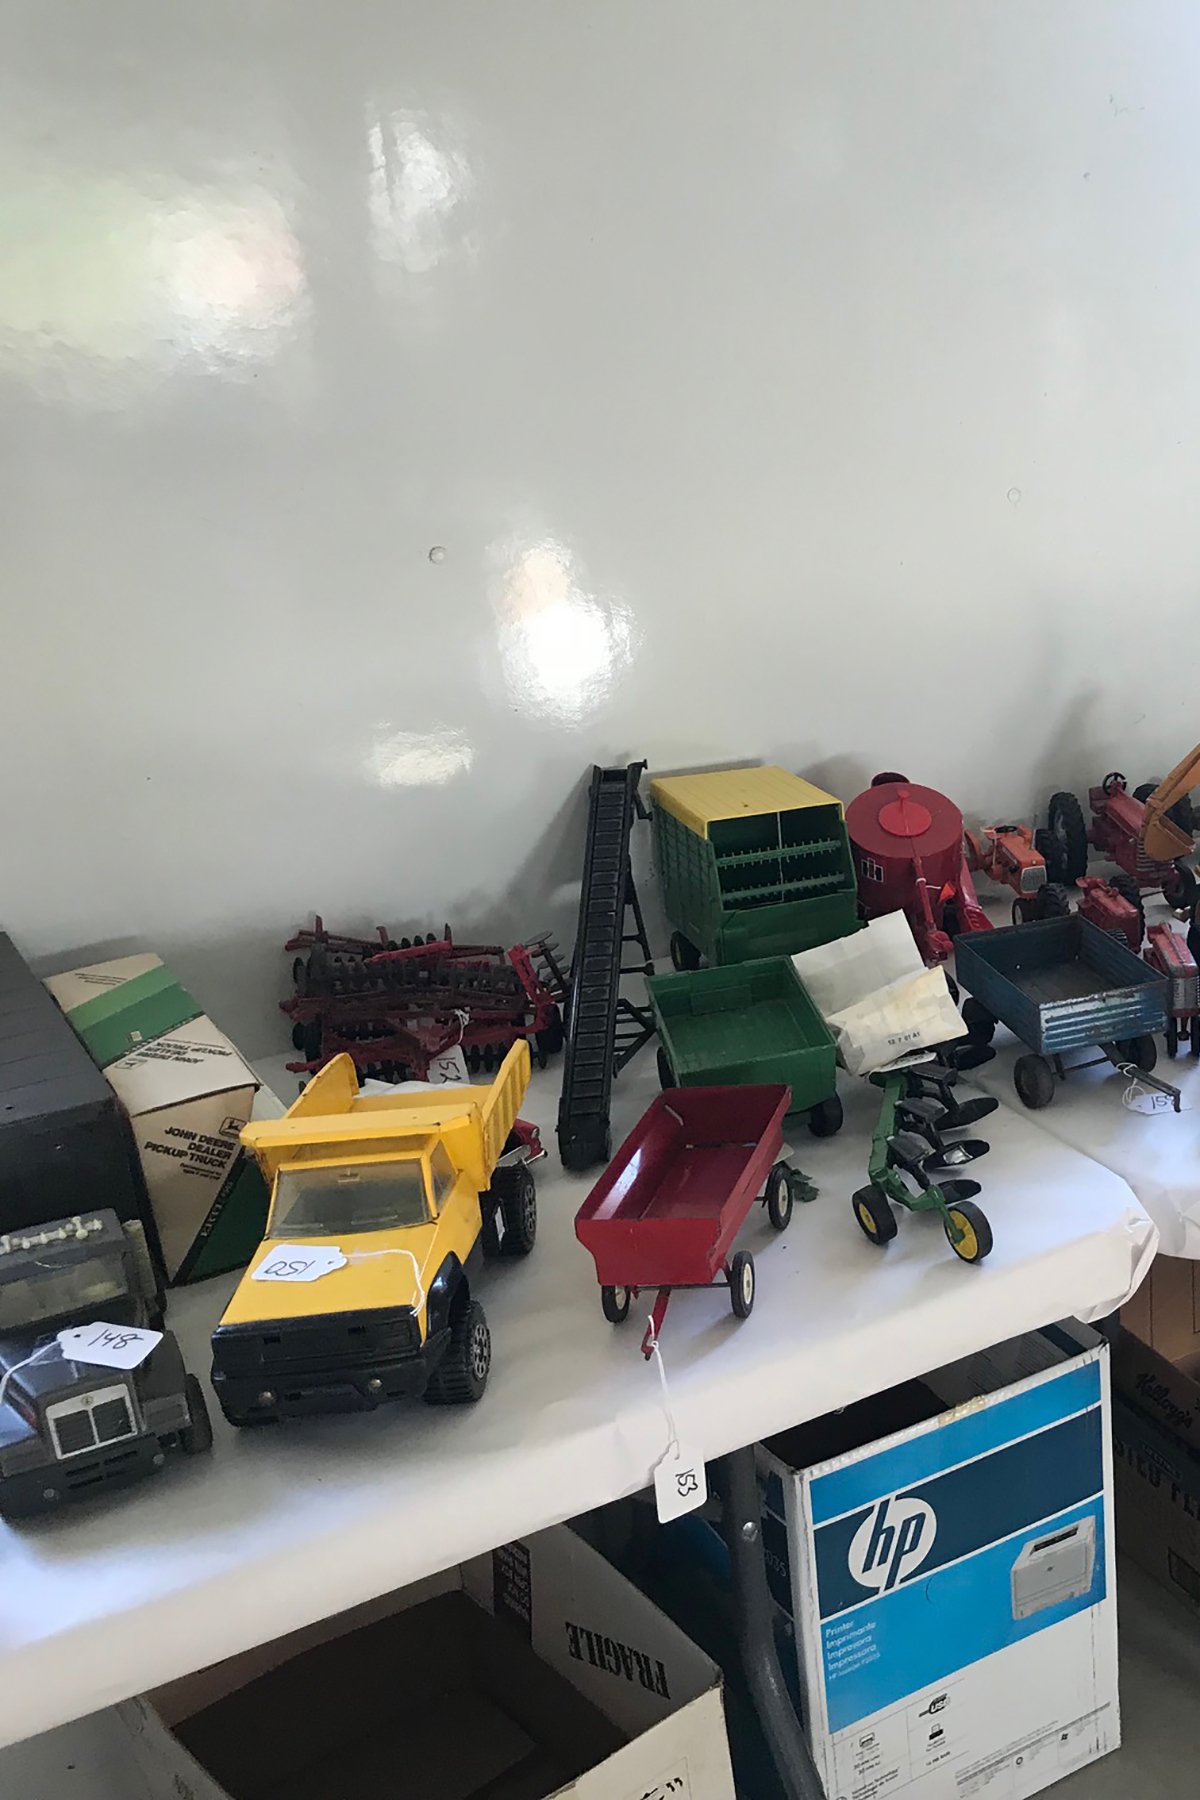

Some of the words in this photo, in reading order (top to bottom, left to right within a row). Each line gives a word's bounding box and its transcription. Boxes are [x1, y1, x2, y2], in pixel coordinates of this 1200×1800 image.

[164, 1126, 197, 1141] JOHN
[198, 1134, 236, 1151] DEERE
[187, 1142, 232, 1160] DEALER
[144, 1141, 188, 1159] PICKUP
[189, 1152, 227, 1169] TRUCK
[87, 1328, 145, 1350] 148
[674, 1467, 699, 1498] 153
[862, 1496, 927, 1592] hp
[825, 1620, 855, 1638] Printer
[826, 1621, 876, 1650] Imprimante
[565, 1621, 671, 1700] FRAGILE
[827, 1635, 872, 1661] Impresora
[828, 1644, 877, 1671] Impressora
